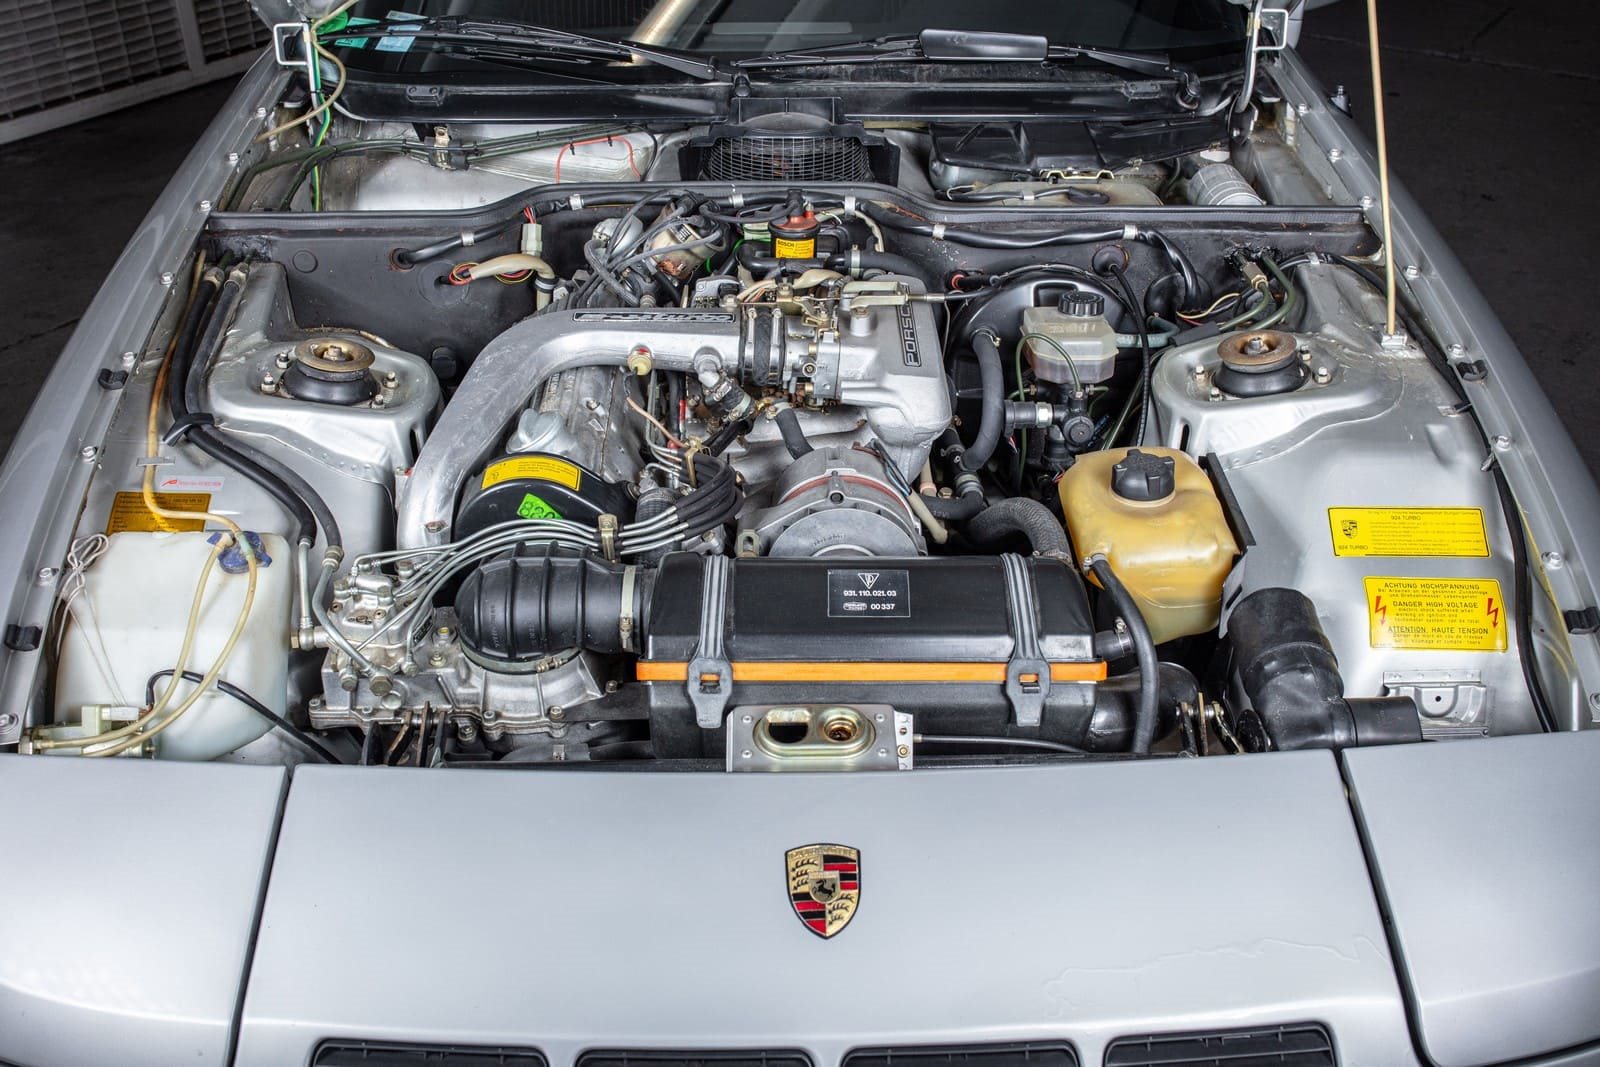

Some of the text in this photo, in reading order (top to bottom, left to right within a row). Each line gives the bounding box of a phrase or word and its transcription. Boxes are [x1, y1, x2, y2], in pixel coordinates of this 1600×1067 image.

[899, 301, 919, 366] PORSC
[1392, 600, 1423, 608] DANGER
[1388, 625, 1489, 635] ATTENTION HAUTE TENSION
